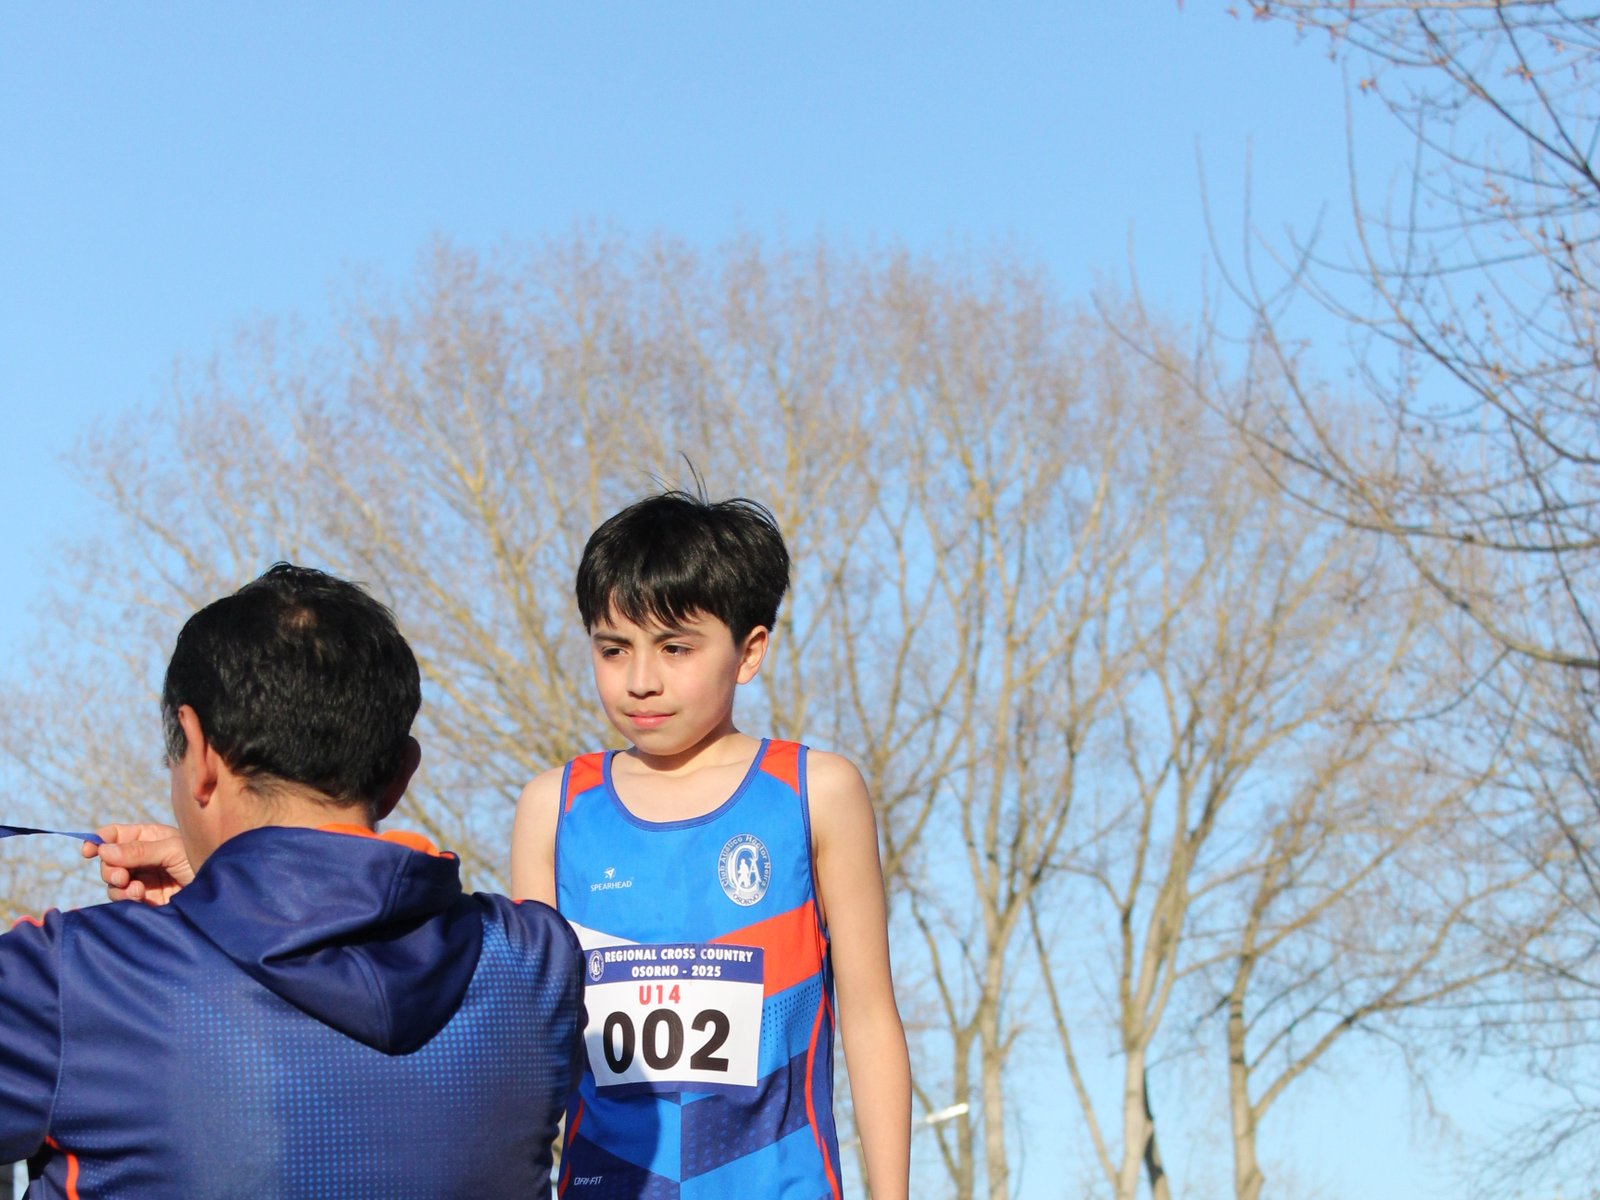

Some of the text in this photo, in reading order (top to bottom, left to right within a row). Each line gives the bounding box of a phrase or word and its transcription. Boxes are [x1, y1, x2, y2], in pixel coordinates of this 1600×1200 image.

[590, 880, 632, 891] SPEARHEAD
[605, 948, 753, 963] REGIONAL CROSS COUNTRY
[632, 965, 679, 978] OSORNO
[691, 966, 721, 977] 2025
[639, 984, 681, 1006] U14
[603, 1008, 731, 1074] 002
